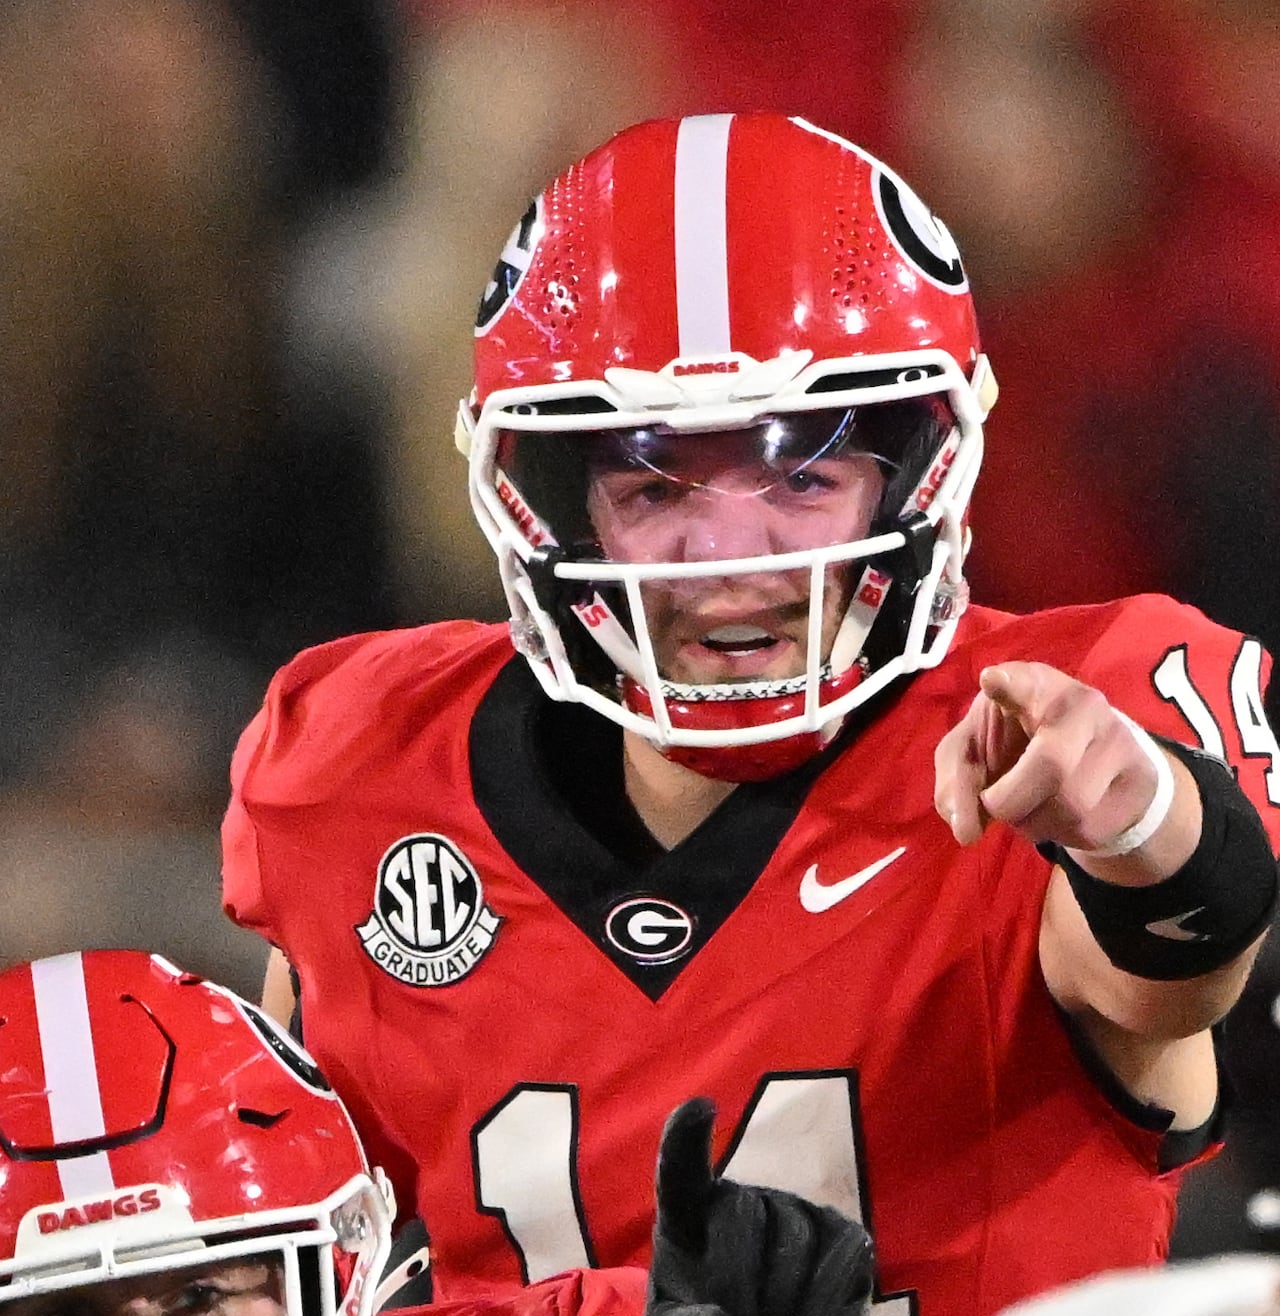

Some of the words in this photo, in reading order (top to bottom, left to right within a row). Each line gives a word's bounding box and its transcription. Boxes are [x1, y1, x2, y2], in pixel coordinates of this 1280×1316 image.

[672, 360, 740, 377] DAWGS
[382, 841, 470, 948] SEC
[373, 938, 485, 985] GRADUATE
[36, 1189, 162, 1235] DAWGS
